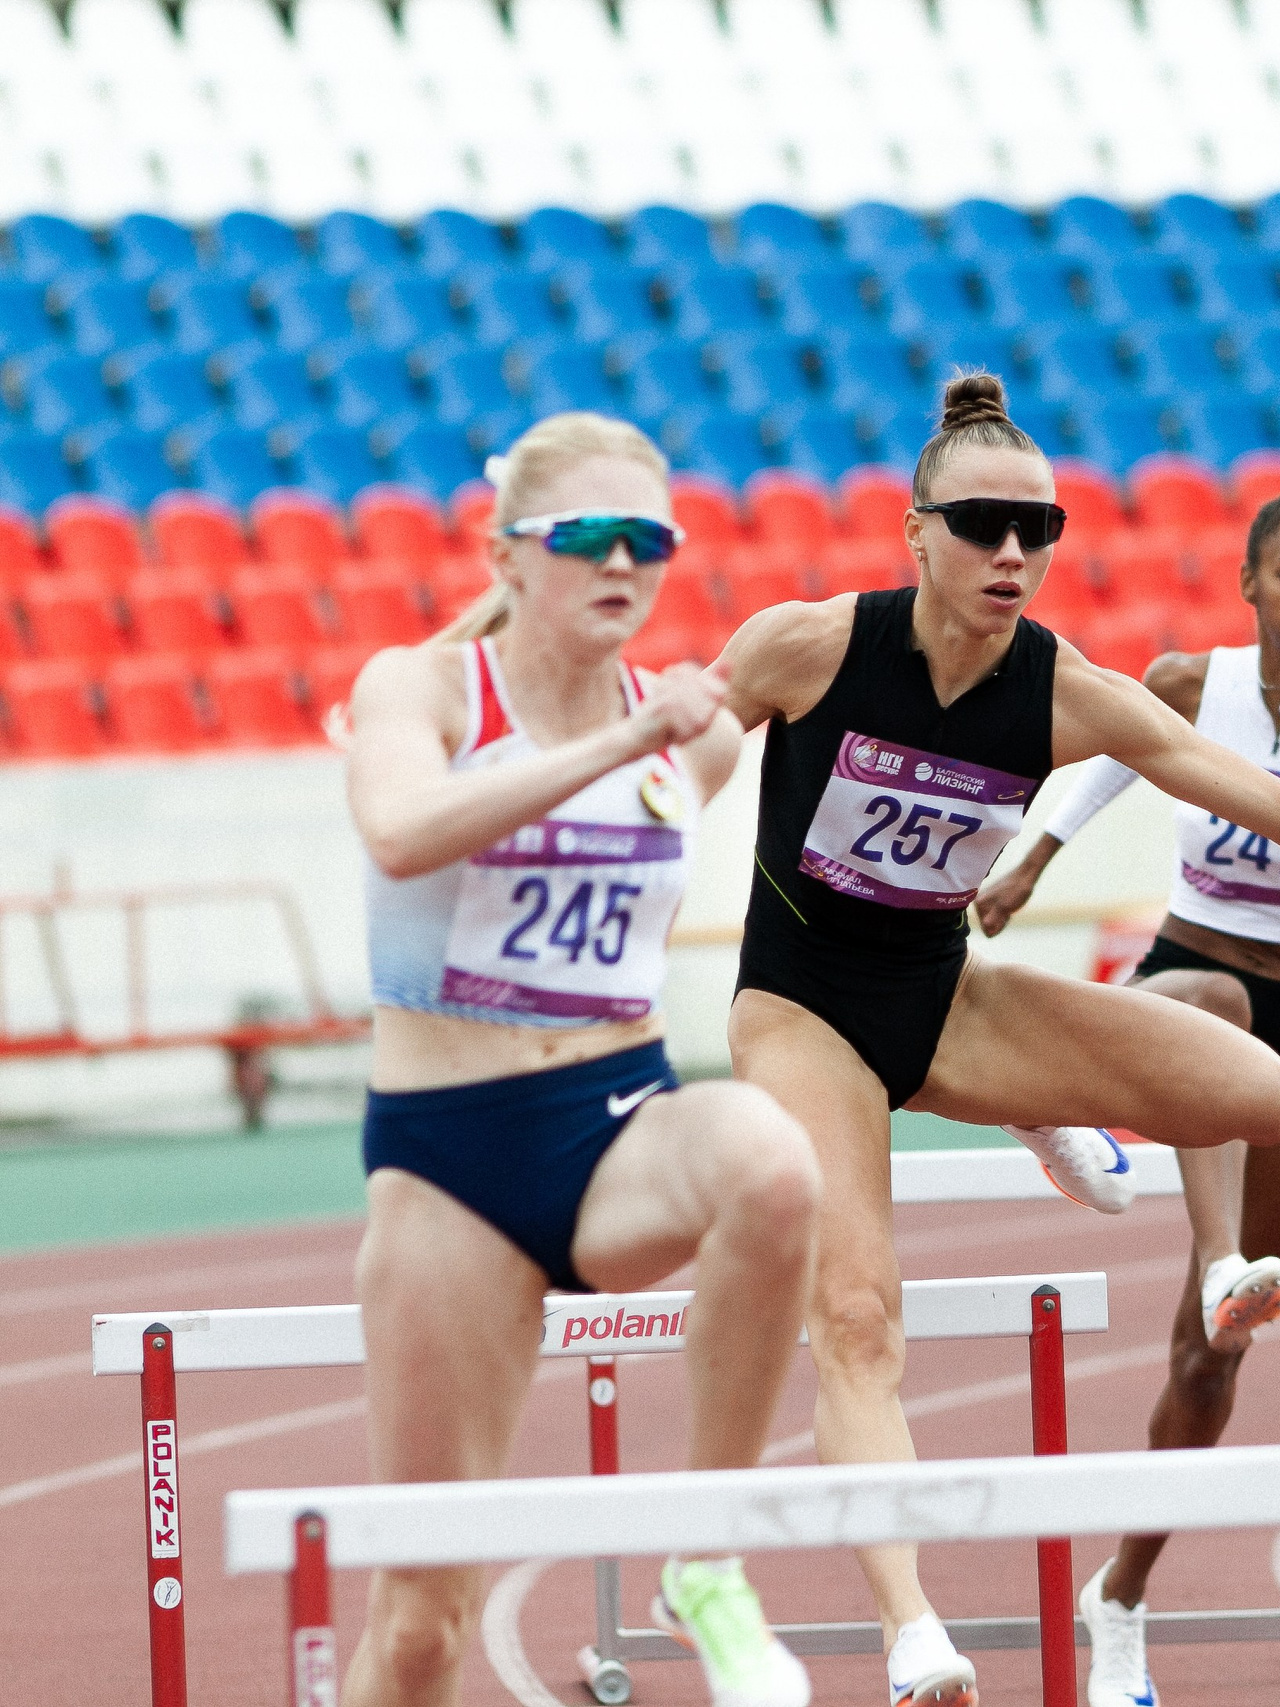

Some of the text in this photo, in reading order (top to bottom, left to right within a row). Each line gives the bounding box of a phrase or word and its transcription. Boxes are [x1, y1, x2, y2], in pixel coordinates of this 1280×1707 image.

[877, 751, 904, 769] НГК
[936, 767, 986, 787] БАЛТИЙСКИЙ
[932, 774, 984, 796] ЛИЗИНГ
[850, 795, 983, 871] 257
[501, 876, 642, 965] 245
[151, 1424, 176, 1546] POLANIK
